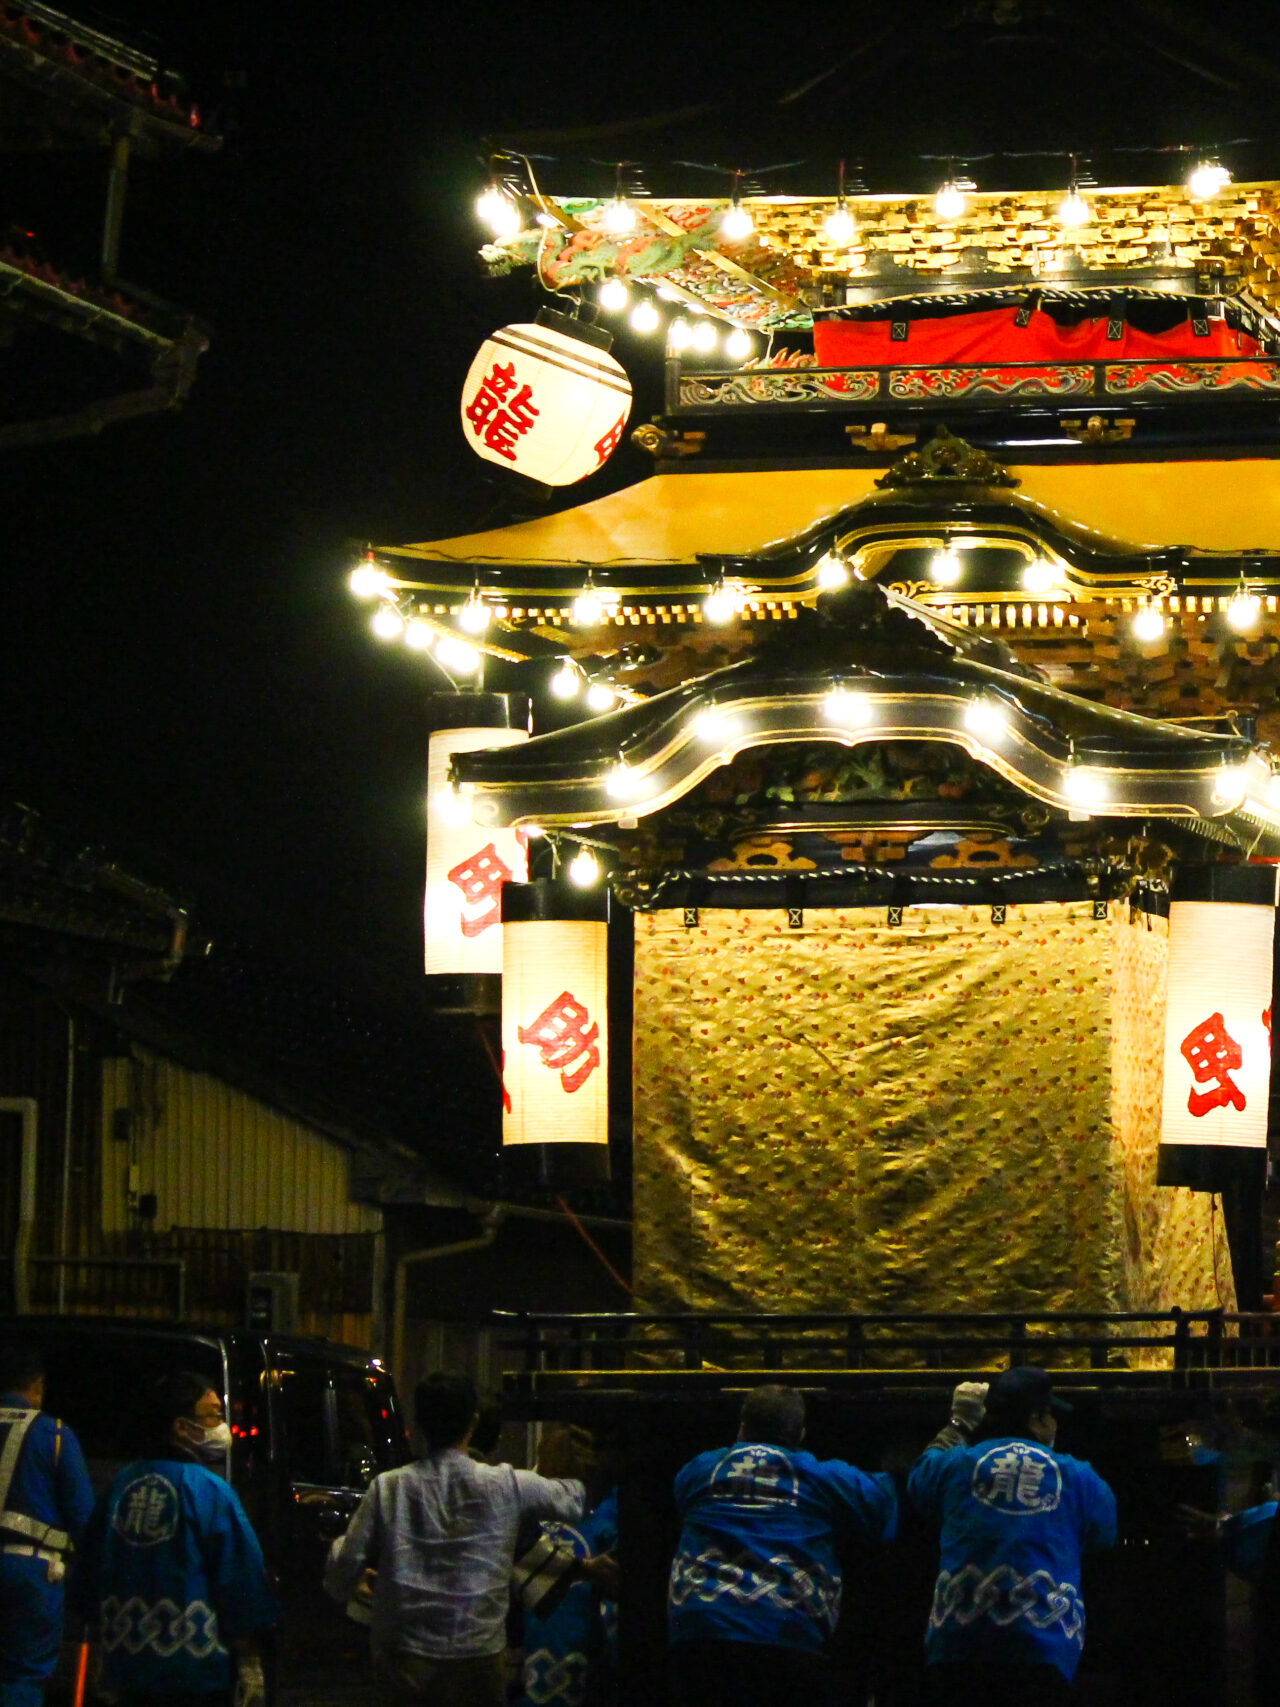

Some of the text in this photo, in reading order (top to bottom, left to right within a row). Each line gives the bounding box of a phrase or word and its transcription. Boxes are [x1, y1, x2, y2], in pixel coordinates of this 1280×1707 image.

[466, 361, 540, 461] 龍
[518, 990, 600, 1093] 助
[1180, 1012, 1246, 1118] 町
[990, 1452, 1047, 1507] 龍
